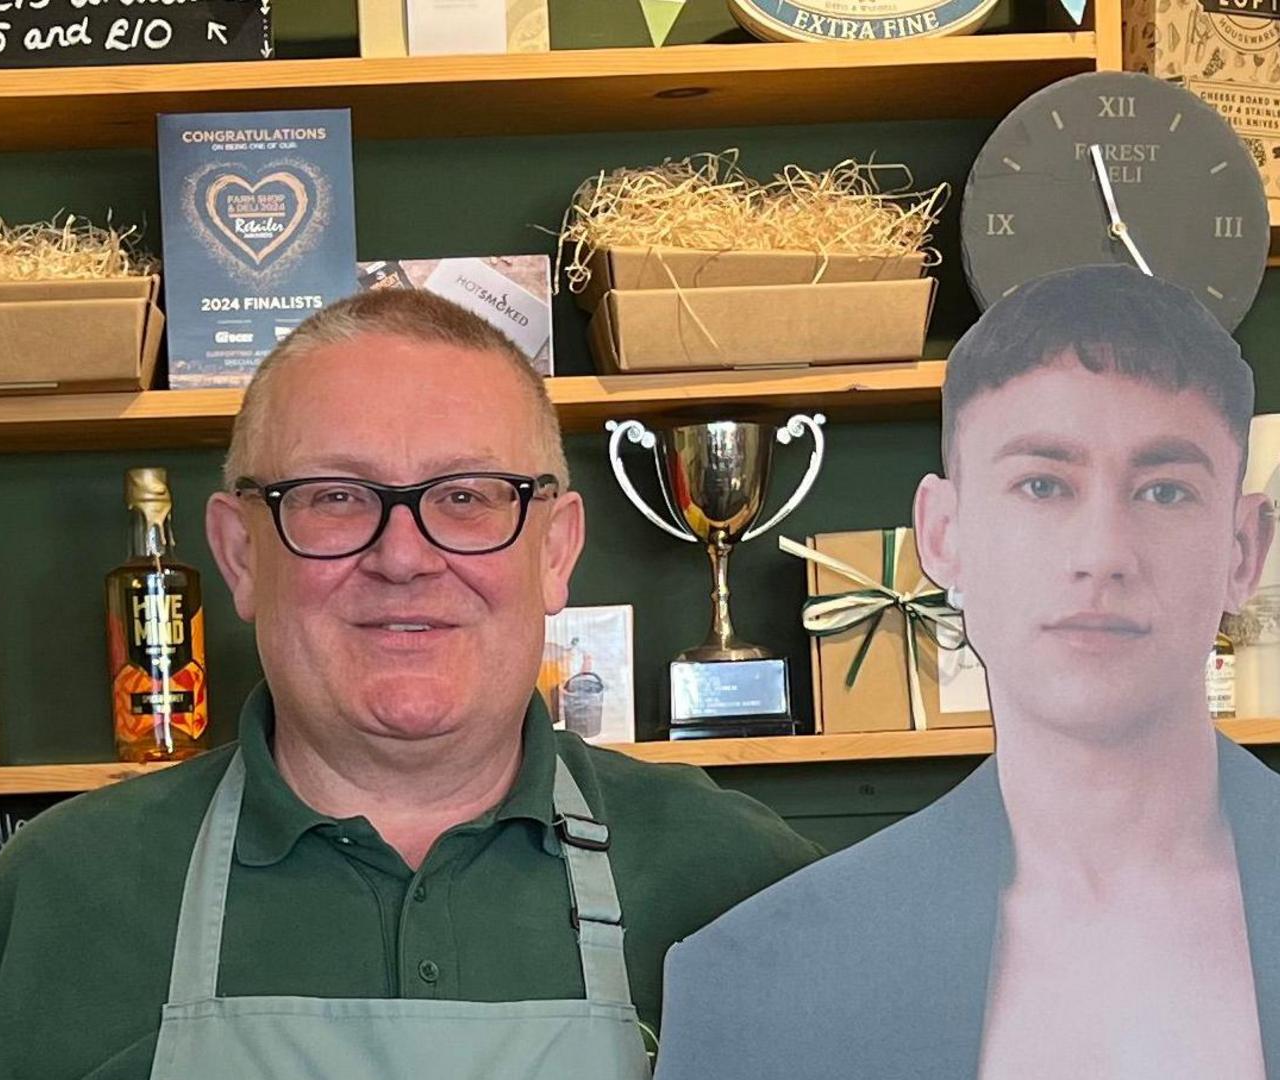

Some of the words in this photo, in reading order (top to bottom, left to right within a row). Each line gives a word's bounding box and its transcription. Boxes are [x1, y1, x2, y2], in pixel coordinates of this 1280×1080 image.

[23, 17, 92, 51] and
[104, 17, 172, 51] £10
[792, 10, 876, 39] EXTRA
[884, 11, 940, 38] FINE
[1099, 96, 1136, 117] XII
[1200, 91, 1236, 103] CHEESE
[1239, 95, 1270, 106] BOARD
[1246, 118, 1279, 129] KNIVES
[182, 128, 327, 144] CONGRATULATIONS
[1091, 166, 1142, 183] ELI
[985, 213, 1015, 236] IX
[1214, 216, 1243, 238] III
[201, 298, 240, 311] 2024
[244, 296, 323, 310] FINALISTS
[133, 594, 183, 620] HIVE
[134, 620, 184, 646] MIND
